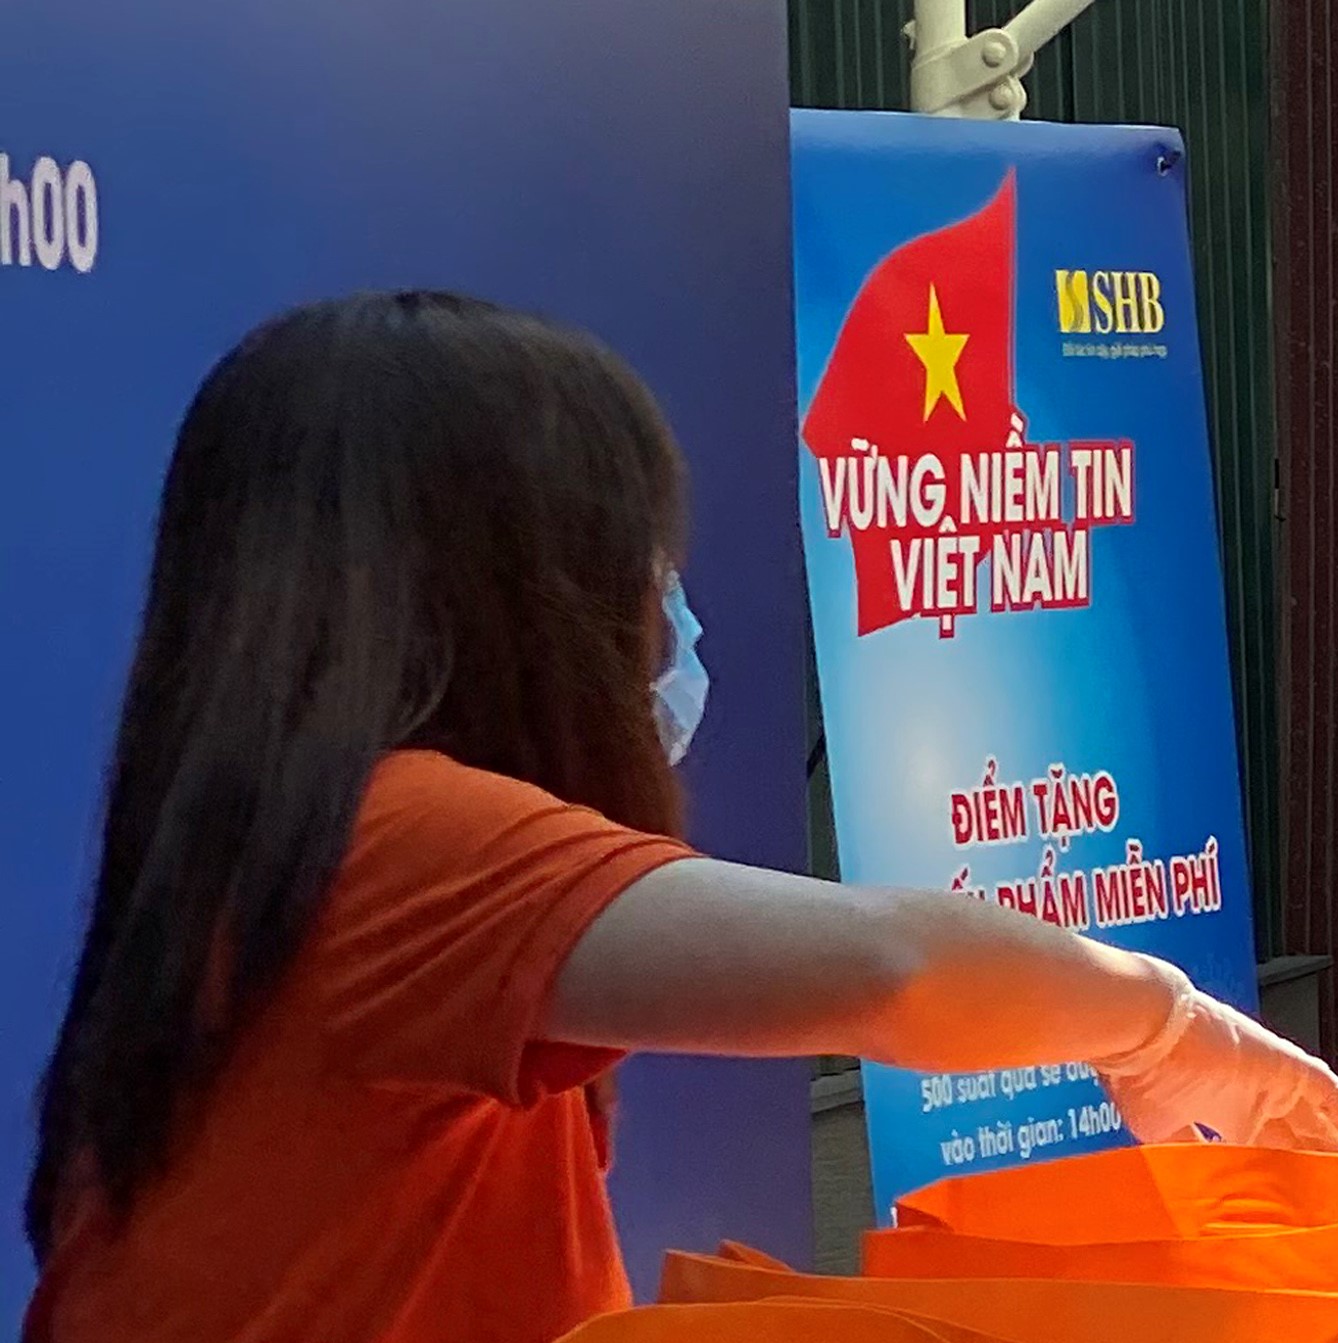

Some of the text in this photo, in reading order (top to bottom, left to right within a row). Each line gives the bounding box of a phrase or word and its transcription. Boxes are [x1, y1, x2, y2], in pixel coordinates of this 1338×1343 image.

[1092, 269, 1165, 334] SHB
[818, 412, 1132, 532] VỮNG NIỀM TIN
[890, 514, 1088, 632] VIỆT NAM
[949, 756, 1119, 850] ĐIỂM TẶNG
[1094, 841, 1168, 926] MIỀN
[1171, 836, 1220, 914] PHÍ
[940, 1129, 976, 1166] vào
[978, 1120, 1014, 1158] thời
[1017, 1116, 1064, 1159] gian:
